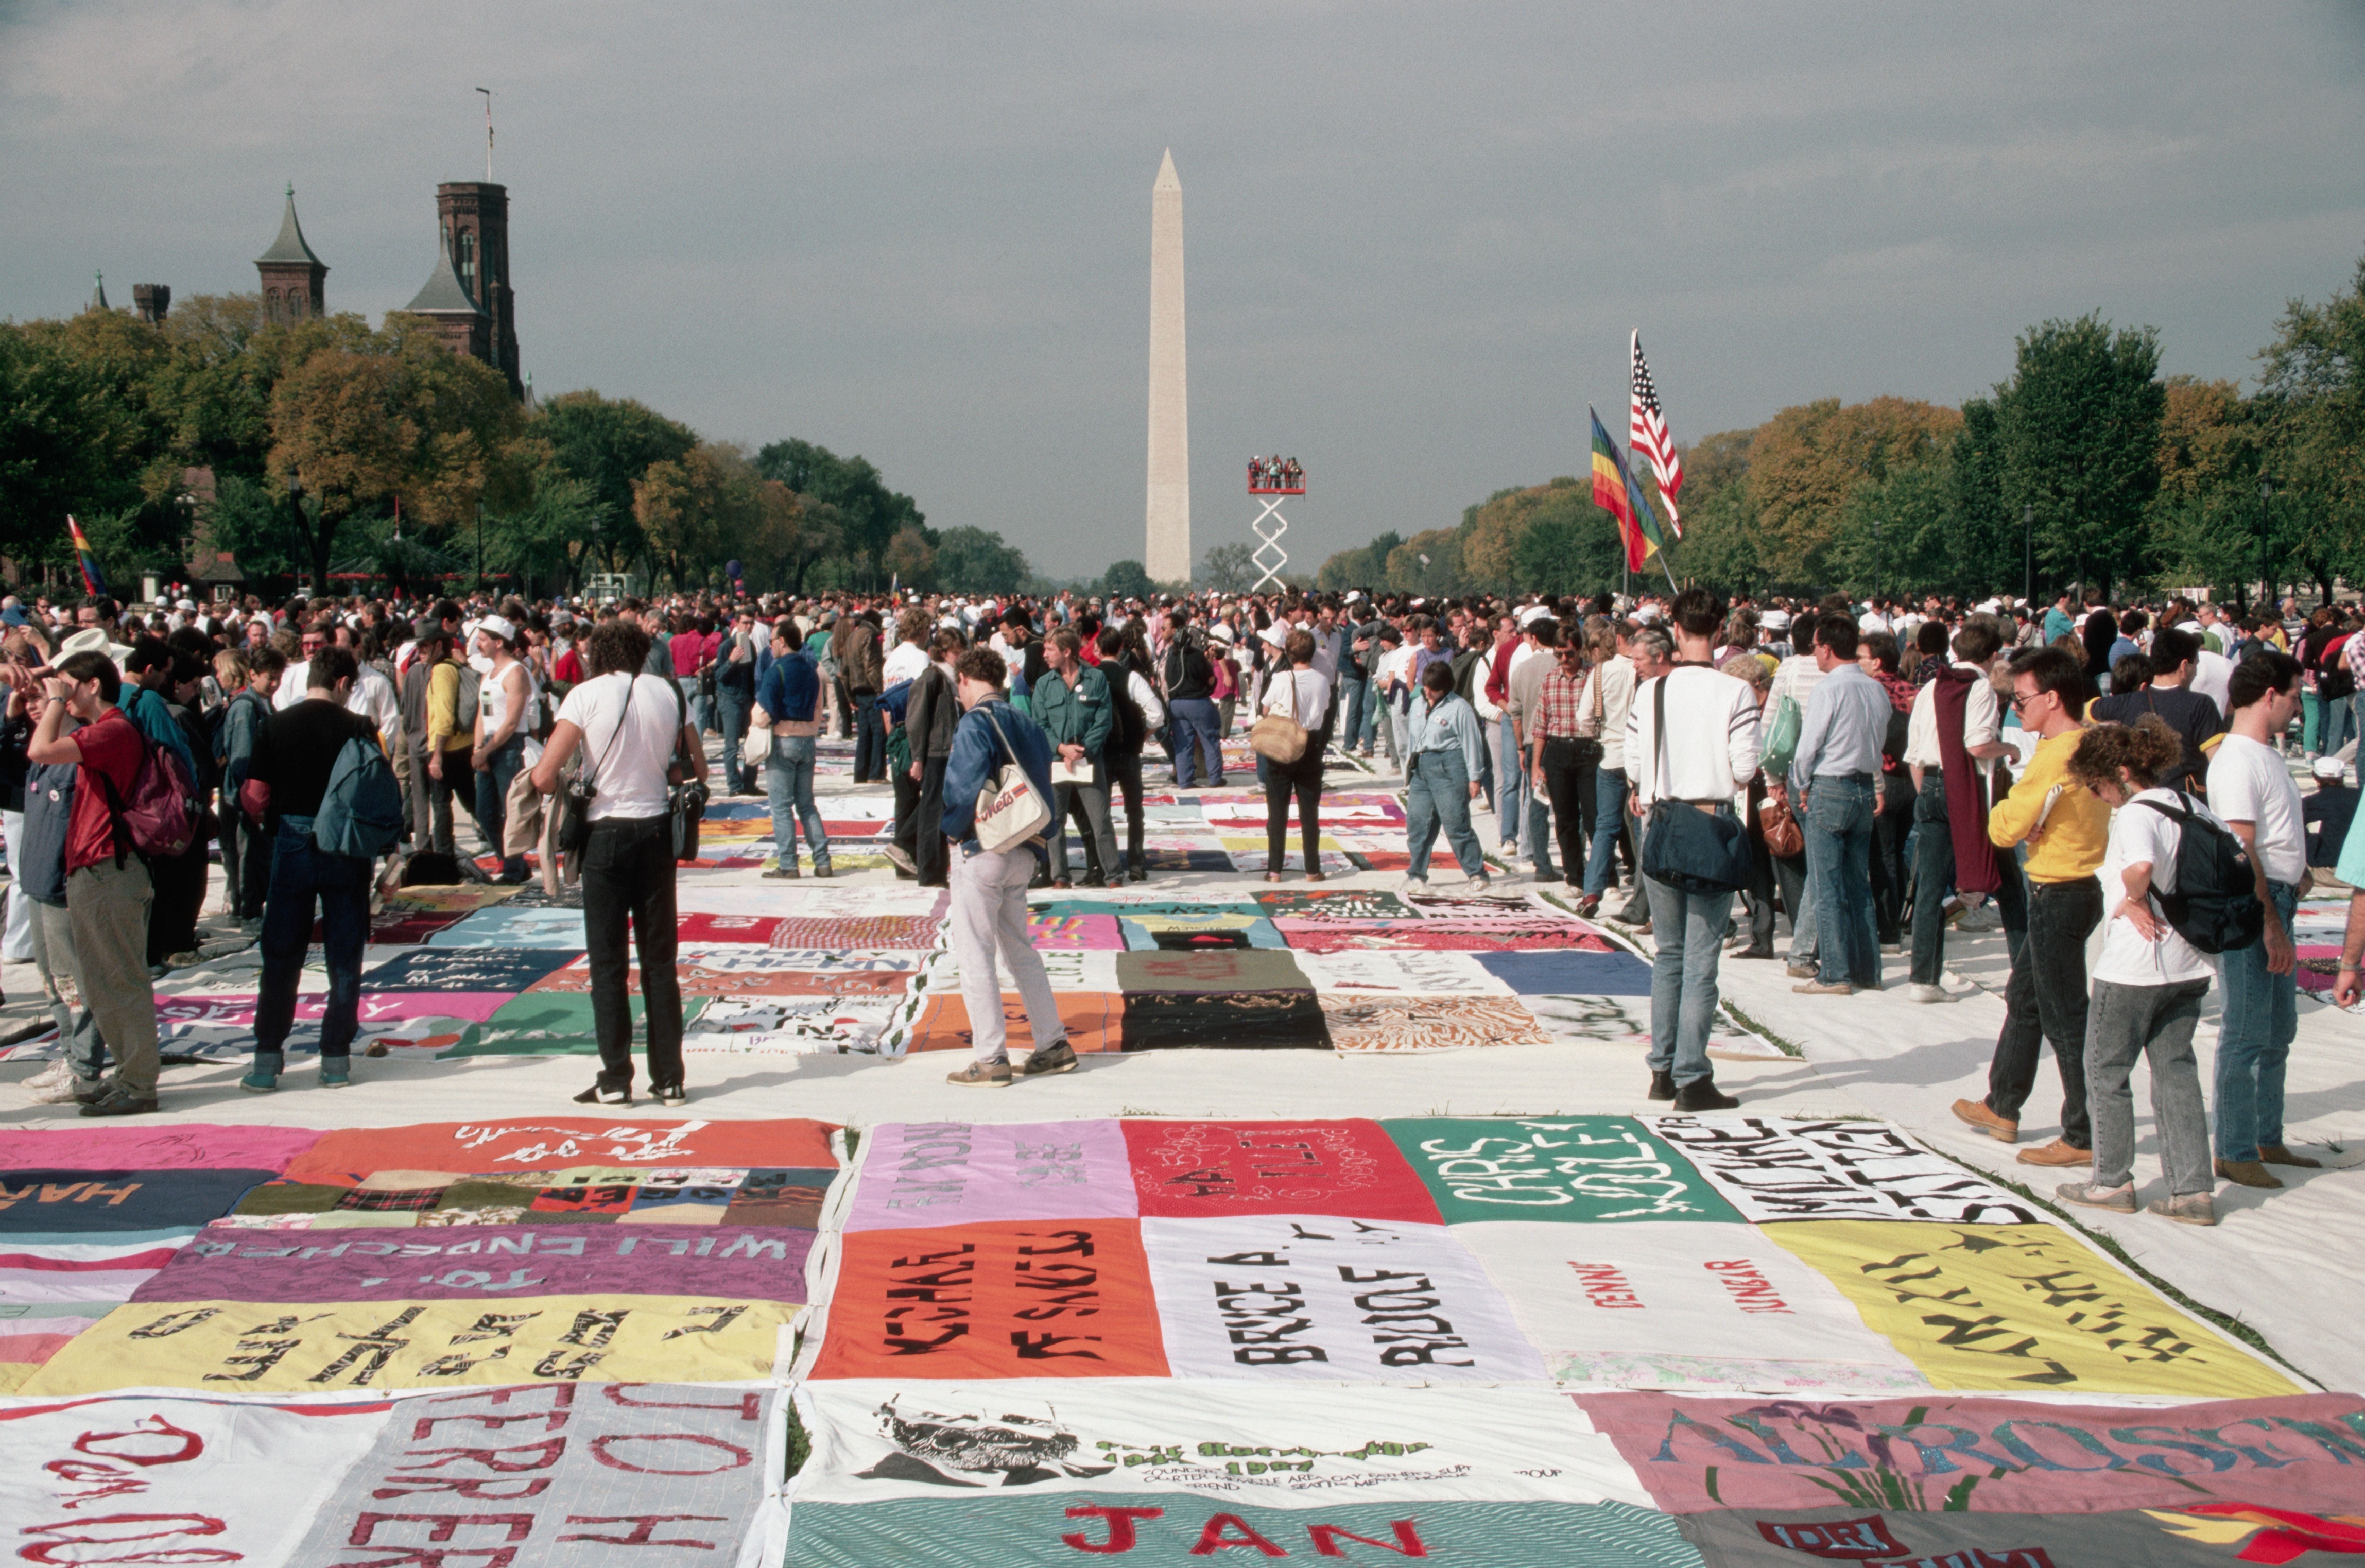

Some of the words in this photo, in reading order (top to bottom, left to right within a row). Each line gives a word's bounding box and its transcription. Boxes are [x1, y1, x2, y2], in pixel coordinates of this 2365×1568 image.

[1420, 1138, 1574, 1205] CHRIS
[1214, 1281, 1330, 1365] BRUCE
[1062, 1506, 1428, 1558] JAN
